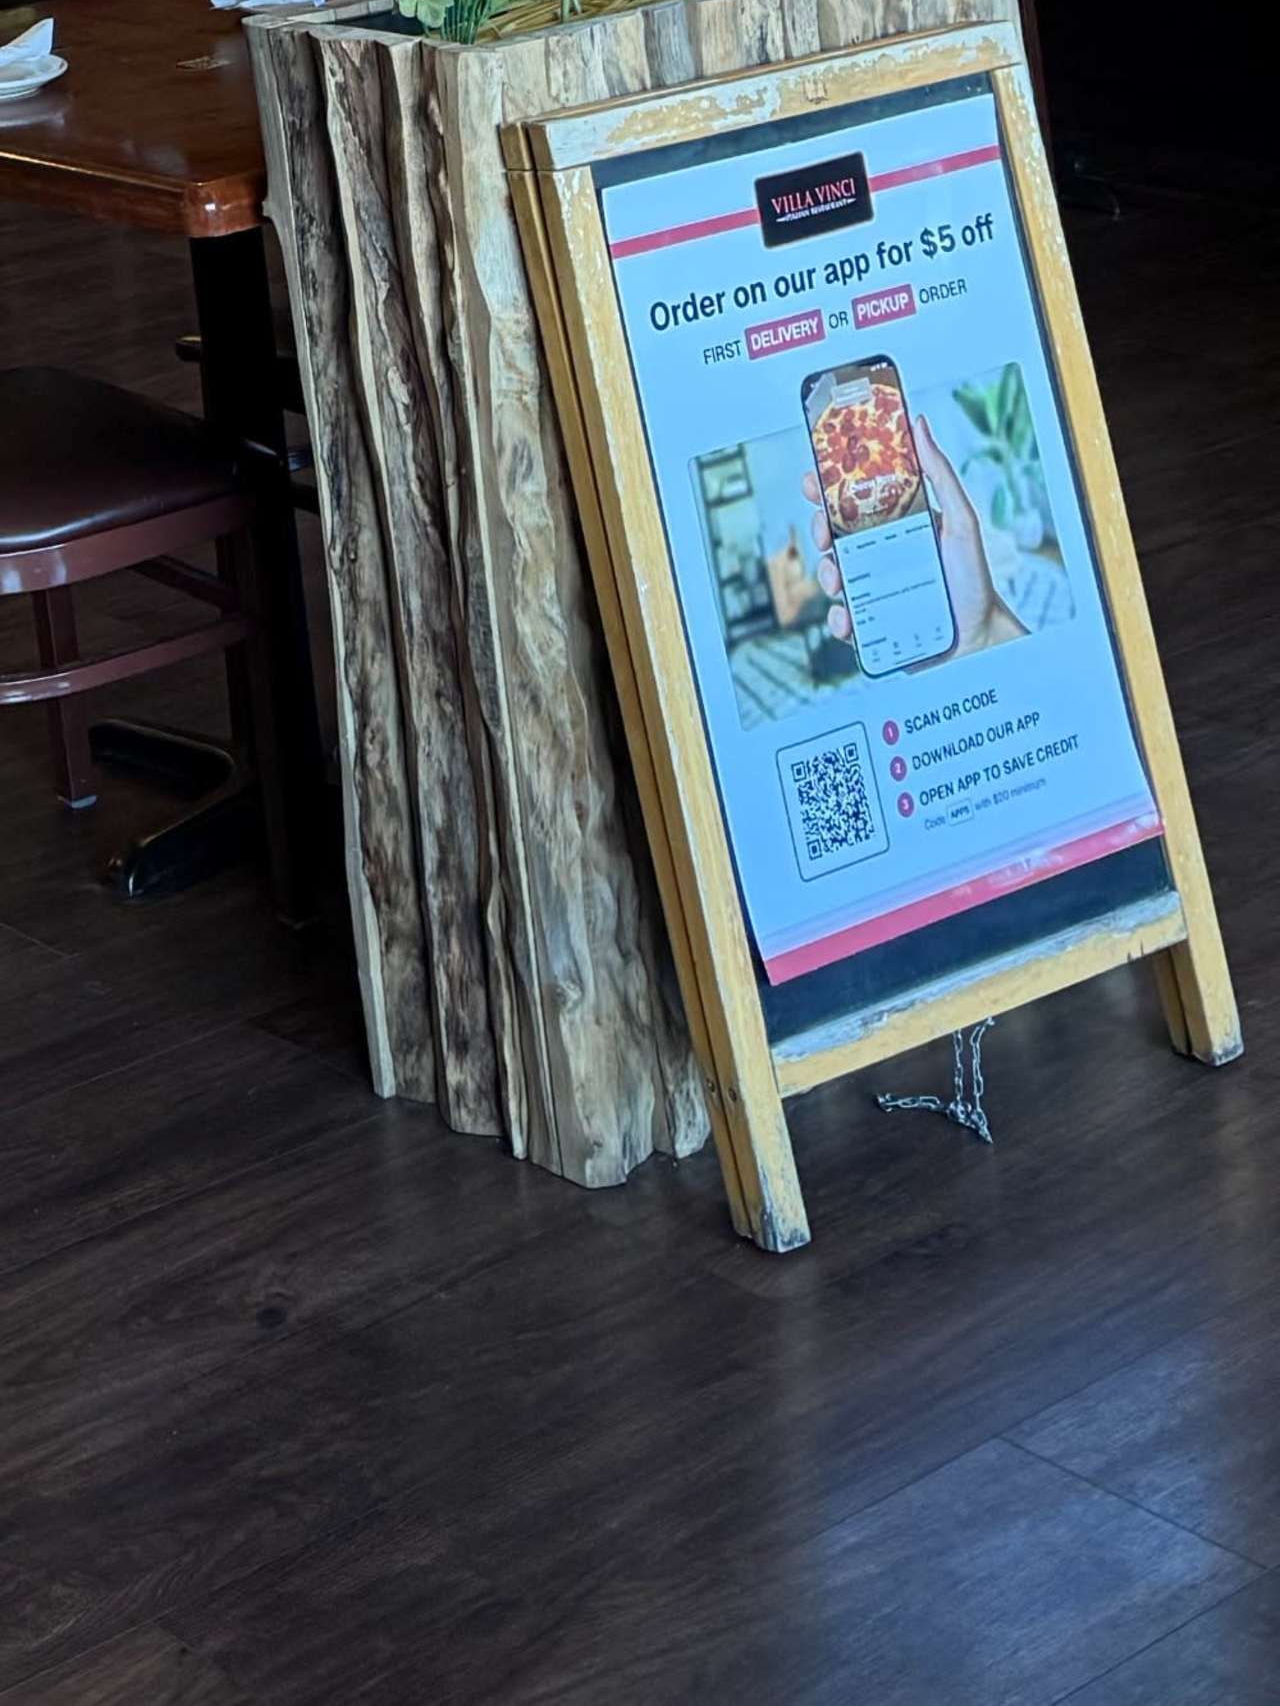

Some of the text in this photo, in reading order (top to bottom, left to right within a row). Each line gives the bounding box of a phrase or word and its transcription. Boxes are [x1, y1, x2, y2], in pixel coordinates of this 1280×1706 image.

[770, 178, 856, 215] VILLA VINCI
[650, 213, 994, 331] Order on our app for $5 off
[703, 278, 968, 365] FIRST DELIVERY OR PICKUP ORDER
[904, 709, 942, 734] SCAN
[962, 688, 999, 713] CODE
[912, 733, 985, 771] DOWNLOAD
[986, 721, 1014, 742] OUR
[1016, 711, 1041, 732] APP
[919, 781, 954, 807] OPEN
[957, 772, 982, 793] APP
[983, 764, 1001, 783] TO
[1003, 751, 1036, 776] SAVE
[1035, 734, 1079, 763] CREDIT
